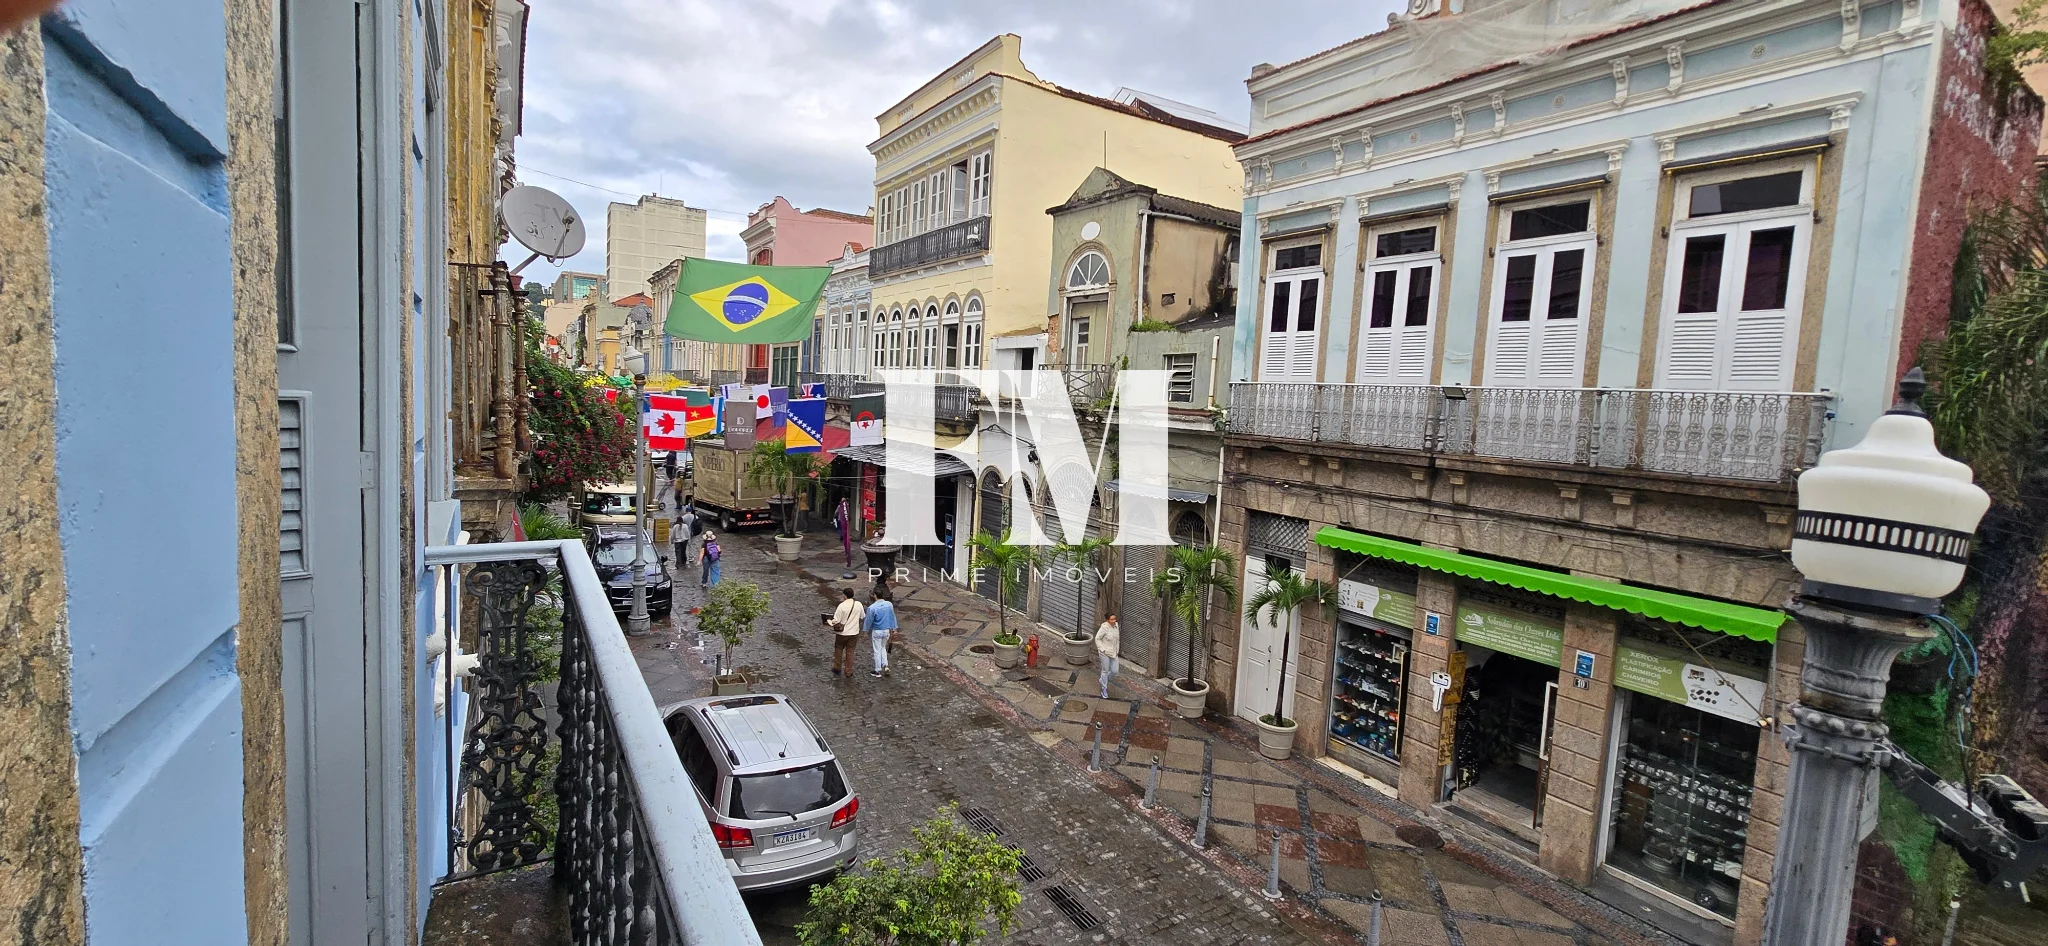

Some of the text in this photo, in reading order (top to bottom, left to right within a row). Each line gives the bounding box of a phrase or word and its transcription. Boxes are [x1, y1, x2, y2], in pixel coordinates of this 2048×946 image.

[1630, 651, 1659, 664] XEROX
[1621, 657, 1673, 675] PLASTIFICAÇÃO
[1622, 665, 1662, 680] CARIMBOS
[1621, 672, 1659, 686] CHAVEIRO
